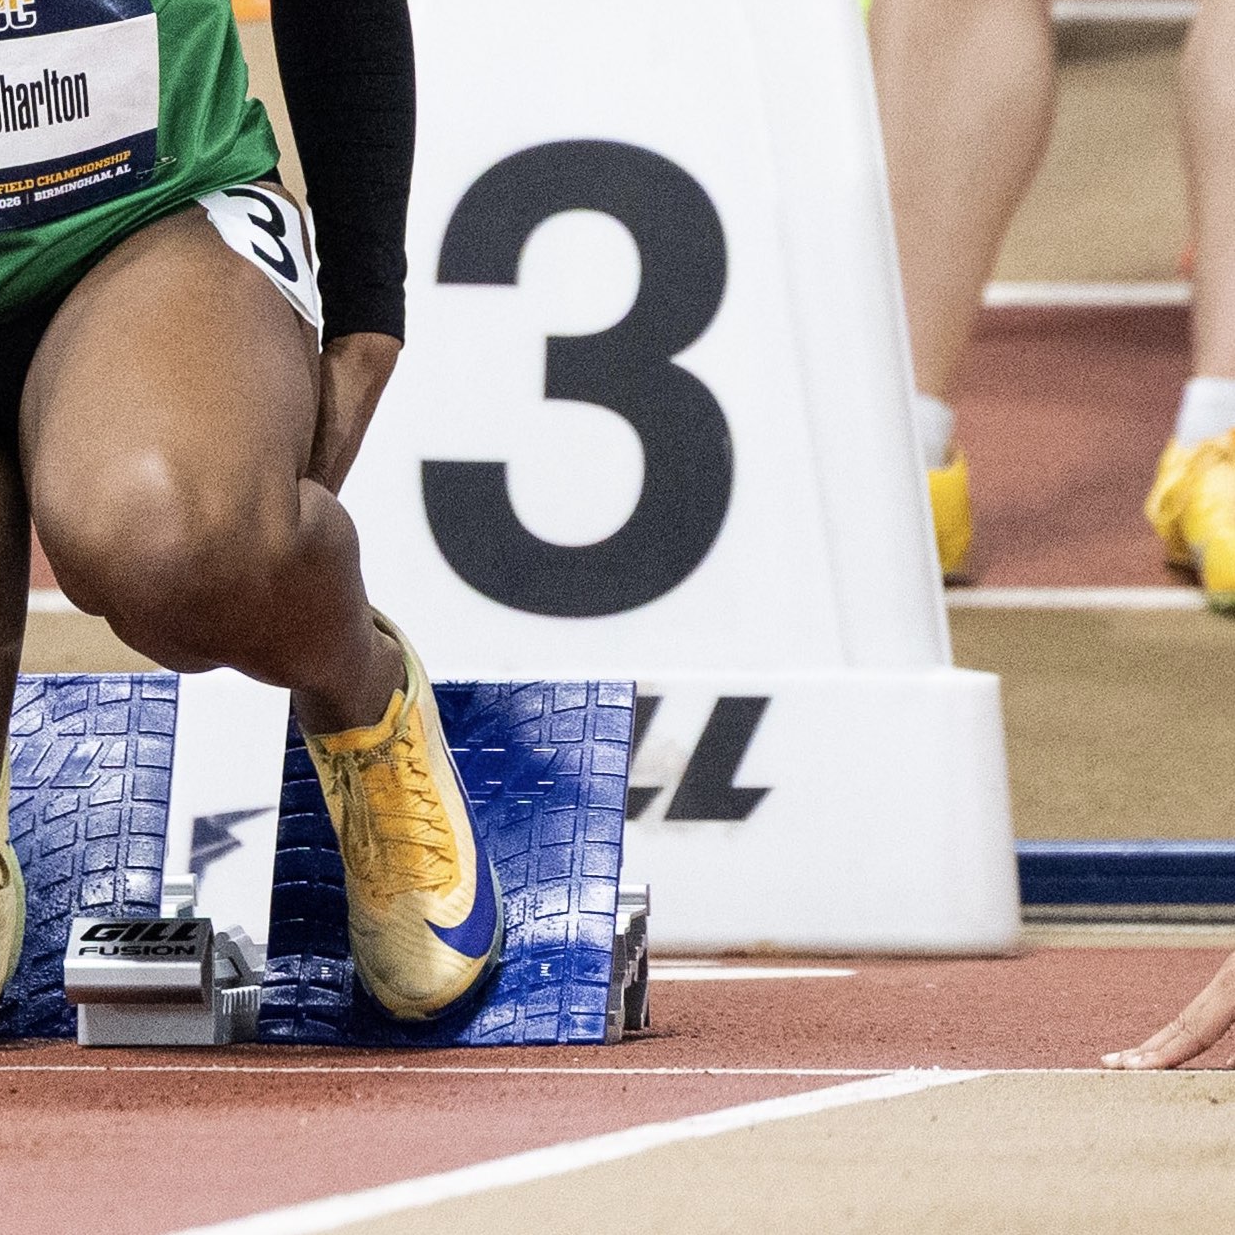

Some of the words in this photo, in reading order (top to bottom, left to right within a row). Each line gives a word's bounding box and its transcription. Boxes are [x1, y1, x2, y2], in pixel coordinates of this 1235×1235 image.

[34, 171, 114, 202] BIRMINGHAM,
[115, 164, 132, 177] AL
[37, 150, 132, 187] CHAMPIONSHIP
[221, 188, 298, 282] 3
[421, 138, 735, 618] 3
[79, 945, 195, 956] FUSION
[80, 923, 200, 942] GILL
